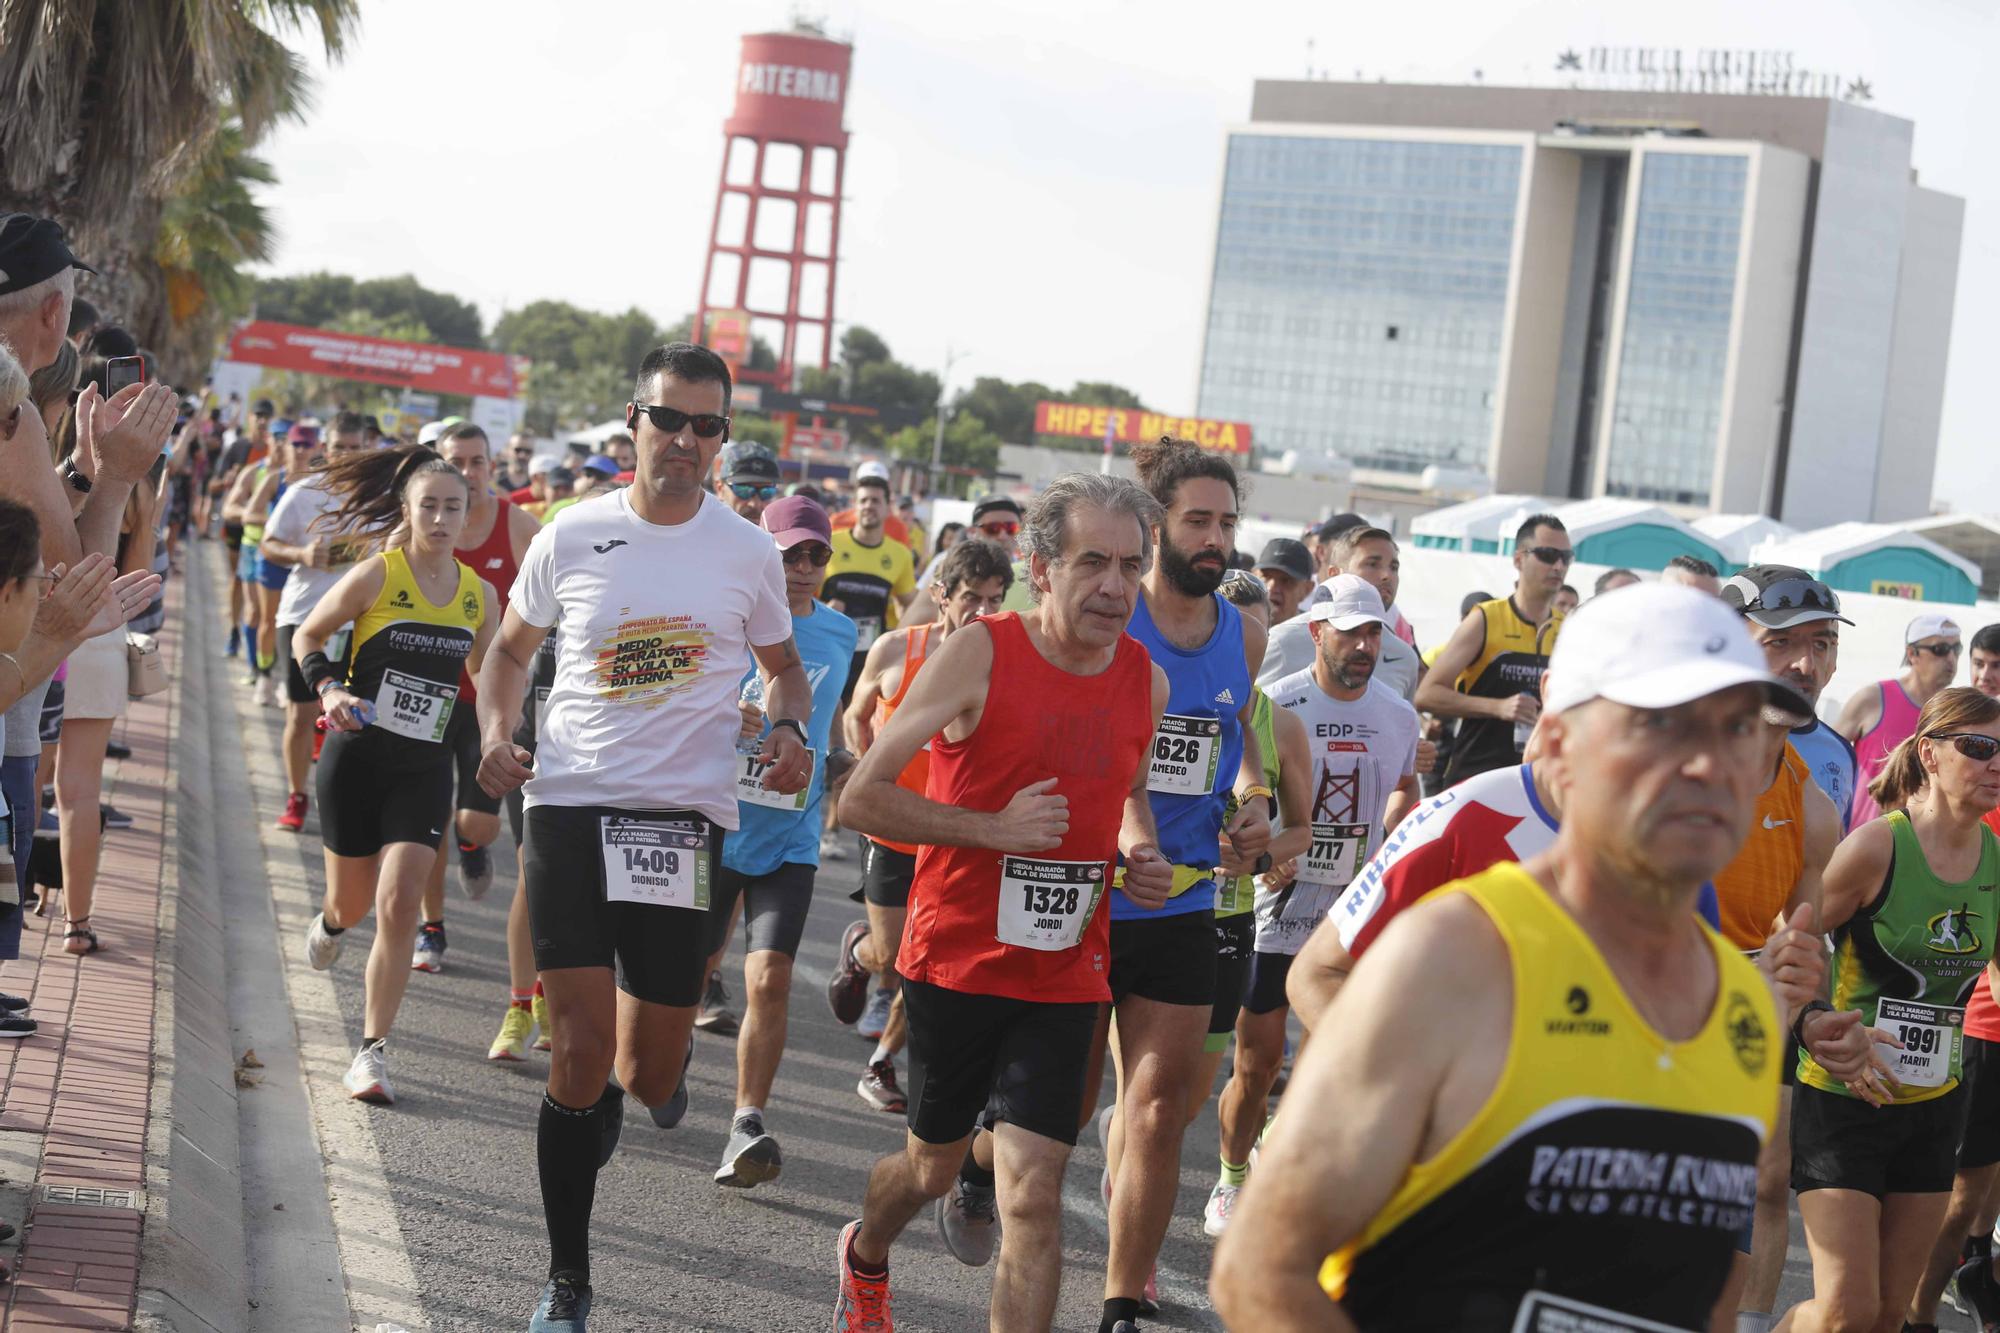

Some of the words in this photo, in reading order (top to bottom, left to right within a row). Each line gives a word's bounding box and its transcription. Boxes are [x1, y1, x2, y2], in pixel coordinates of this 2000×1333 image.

[744, 63, 839, 103] PATERNA
[1047, 405, 1127, 439] HIPER
[1139, 412, 1238, 450] MERCA
[390, 600, 414, 609] VIATOR
[618, 618, 658, 631] CAMPEONATO
[668, 613, 692, 624] ESPAÑA
[626, 628, 640, 637] RUTA
[661, 622, 688, 632] MARATÓN
[695, 622, 706, 630] 5KM
[390, 630, 434, 648] PATERNA
[617, 637, 662, 655] MEDIO
[614, 644, 688, 664] MARATÓN
[636, 658, 668, 672] VILA
[672, 657, 691, 668] DE
[610, 670, 673, 688] PATERNA
[393, 690, 432, 716] 1832
[1215, 696, 1234, 705] adidas
[394, 711, 420, 724] ANDREA
[1316, 723, 1354, 738] EDP
[1151, 763, 1187, 776] AMEDEO
[738, 778, 757, 788] JOSE
[623, 848, 680, 875] 1409
[698, 860, 706, 876] BOX
[1013, 862, 1032, 871] MEDIA
[1034, 865, 1066, 873] MARATÓN
[1308, 861, 1335, 870] RAFAEL
[631, 874, 669, 887] DIONISIO
[1013, 869, 1028, 877] VILA
[1039, 872, 1066, 880] PATERNA
[1024, 884, 1079, 915] 1328
[1034, 918, 1062, 930] JORDI
[1887, 1004, 1905, 1012] MEDIA
[1906, 1007, 1935, 1016] MARATÓN
[1911, 1013, 1935, 1022] PATERNA
[1899, 1025, 1941, 1055] 1991
[1900, 1054, 1930, 1068] MARIVI
[1528, 1145, 1668, 1192] PATERNA
[1526, 1190, 1611, 1215] CLUB
